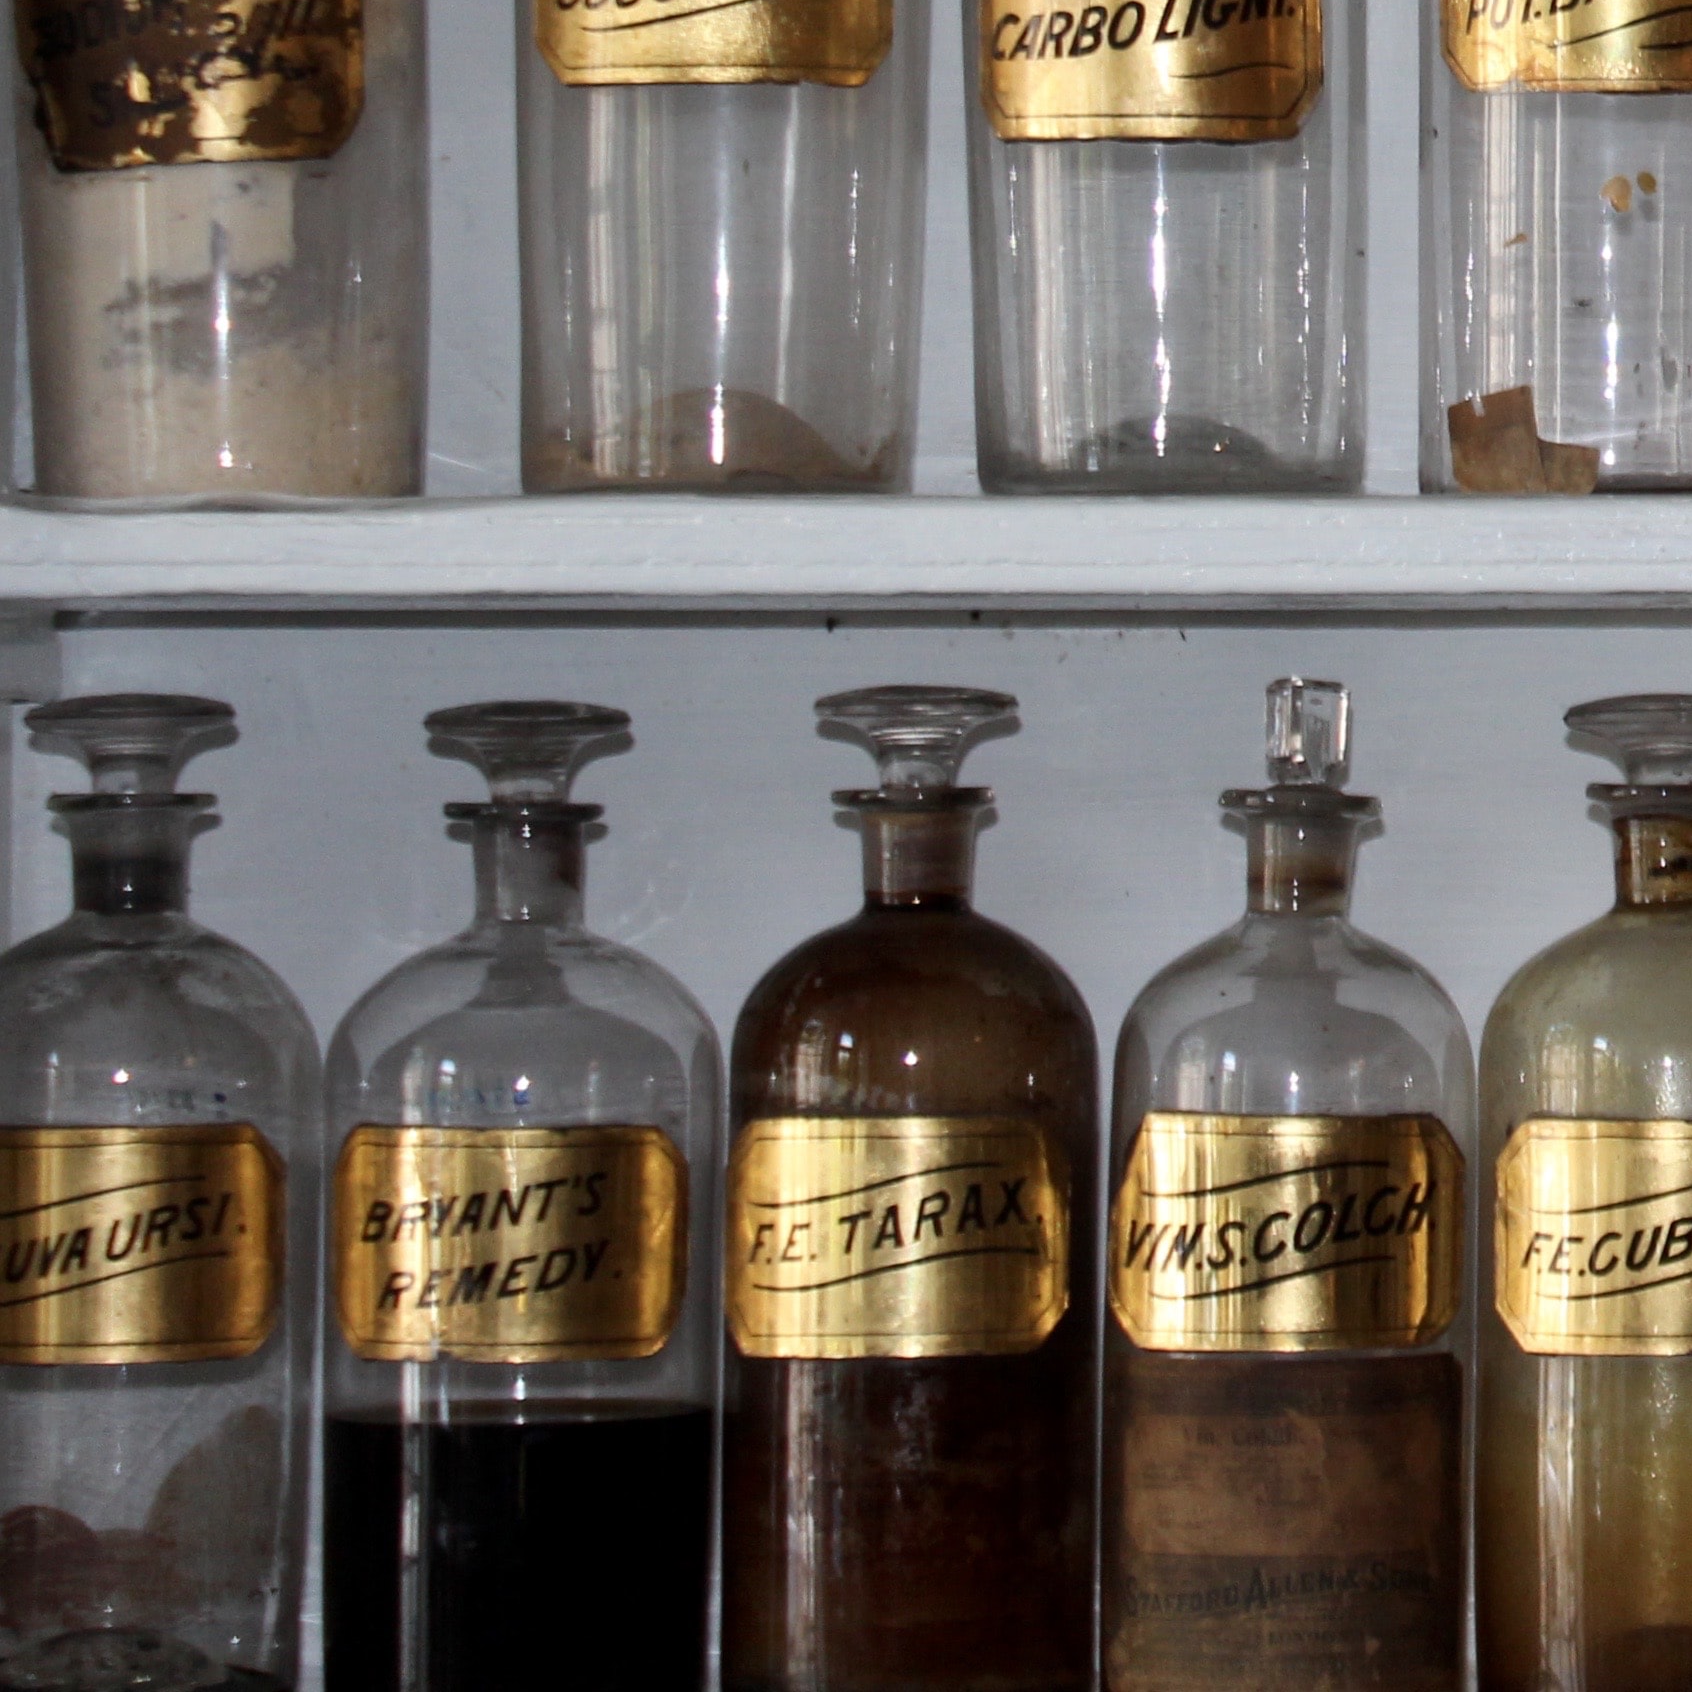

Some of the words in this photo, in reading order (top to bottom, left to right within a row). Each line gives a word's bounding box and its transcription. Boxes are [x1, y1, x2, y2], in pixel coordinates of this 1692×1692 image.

[991, 1, 1144, 62] CARBO
[360, 1171, 609, 1244] BRYANT'S
[7, 1226, 91, 1285] UVA
[377, 1239, 624, 1310] REMEDY.
